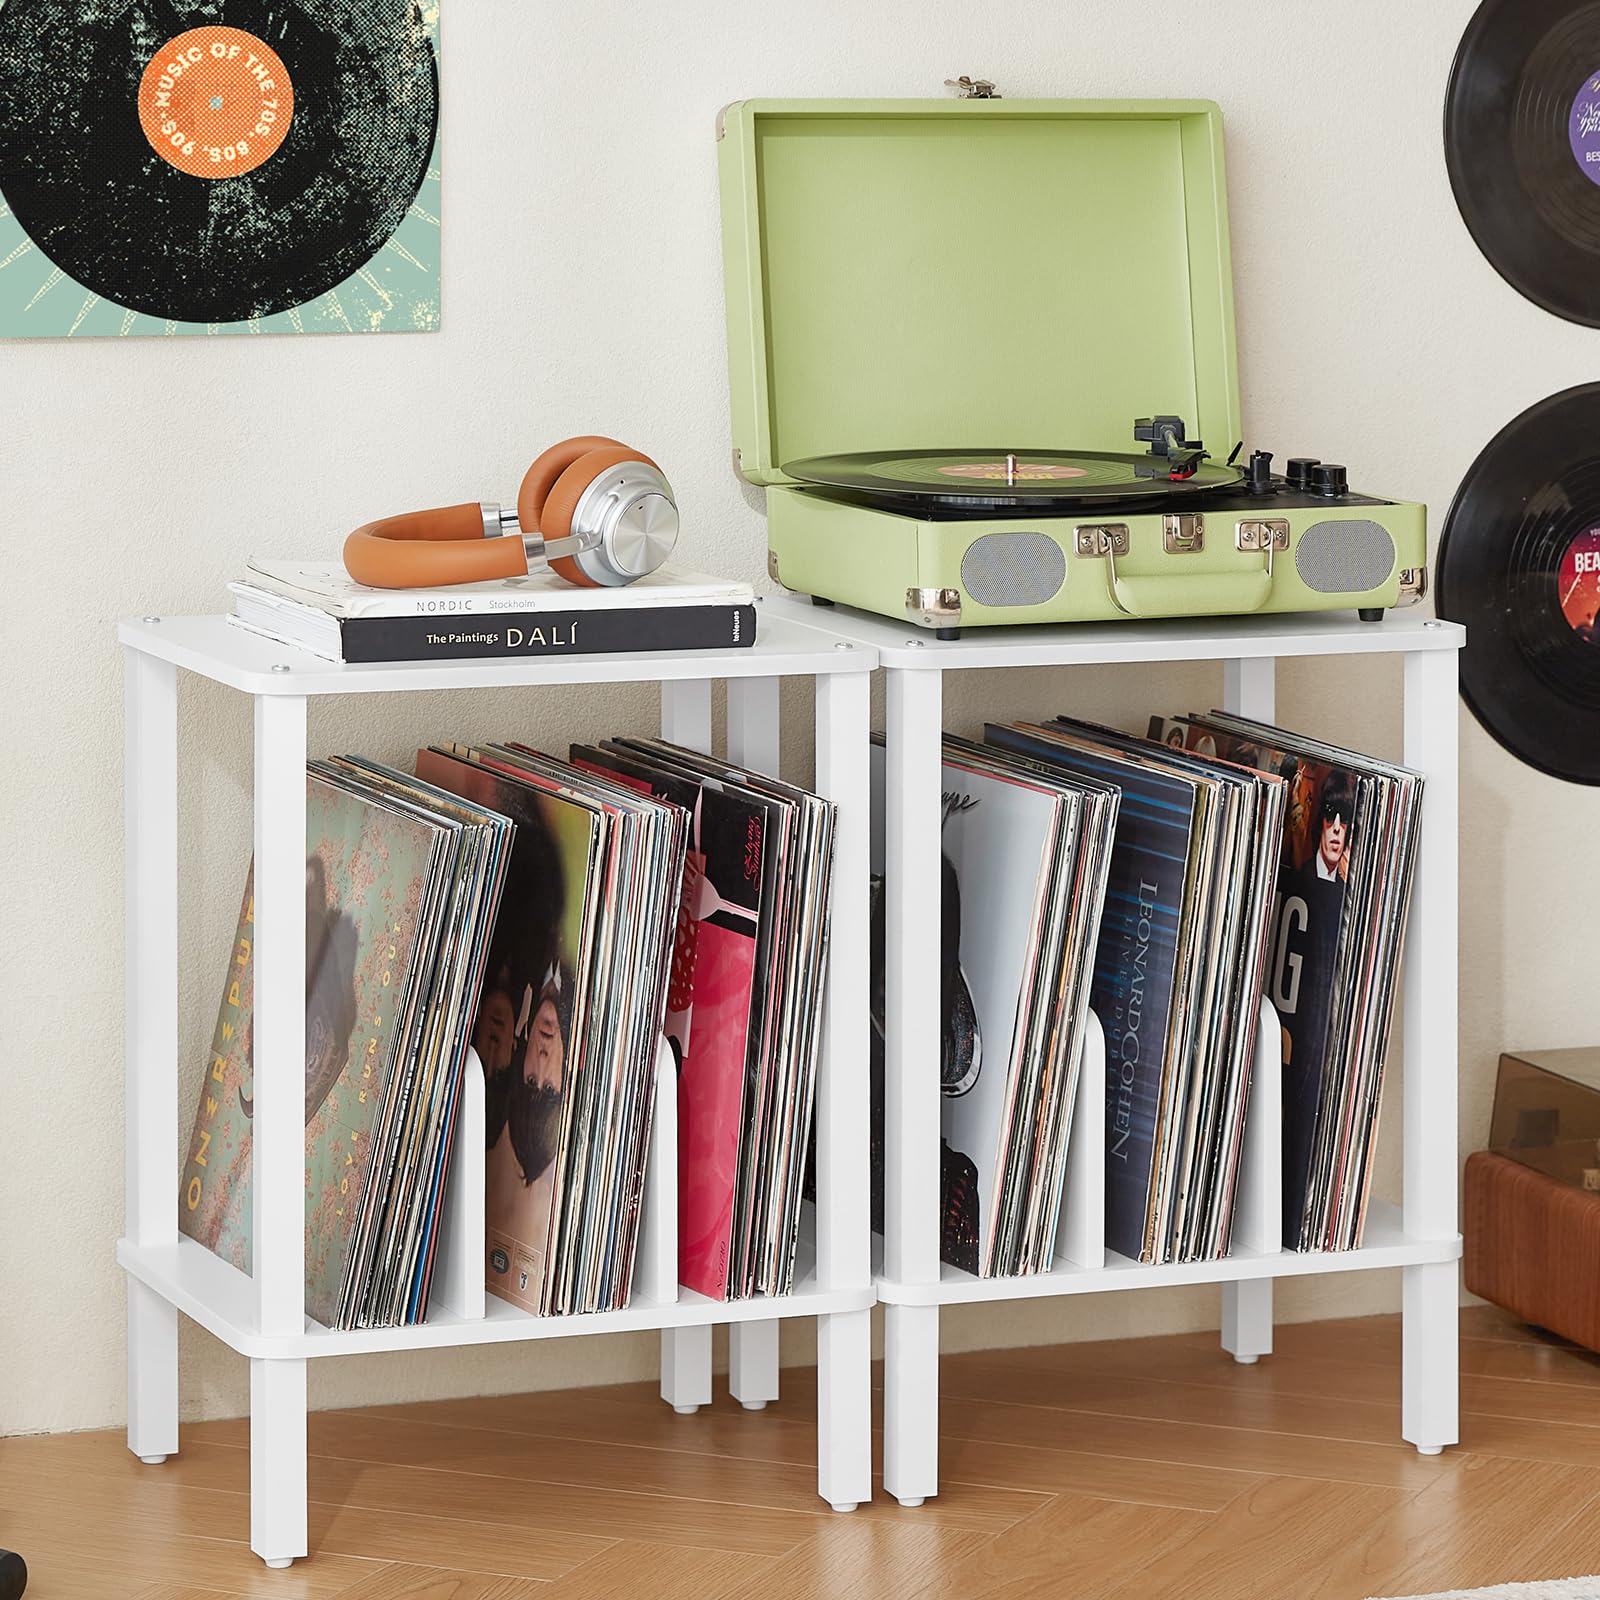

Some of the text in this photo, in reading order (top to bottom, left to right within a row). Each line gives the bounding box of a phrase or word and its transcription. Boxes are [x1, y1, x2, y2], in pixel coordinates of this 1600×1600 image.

[155, 46, 203, 108] MUSIC
[210, 42, 242, 60] OF
[244, 52, 276, 93] THE
[416, 599, 537, 612] NORDIC Stockholm
[426, 621, 578, 647] The Paintings DALÍ
[335, 922, 401, 1217] LOVE RUNS OUT
